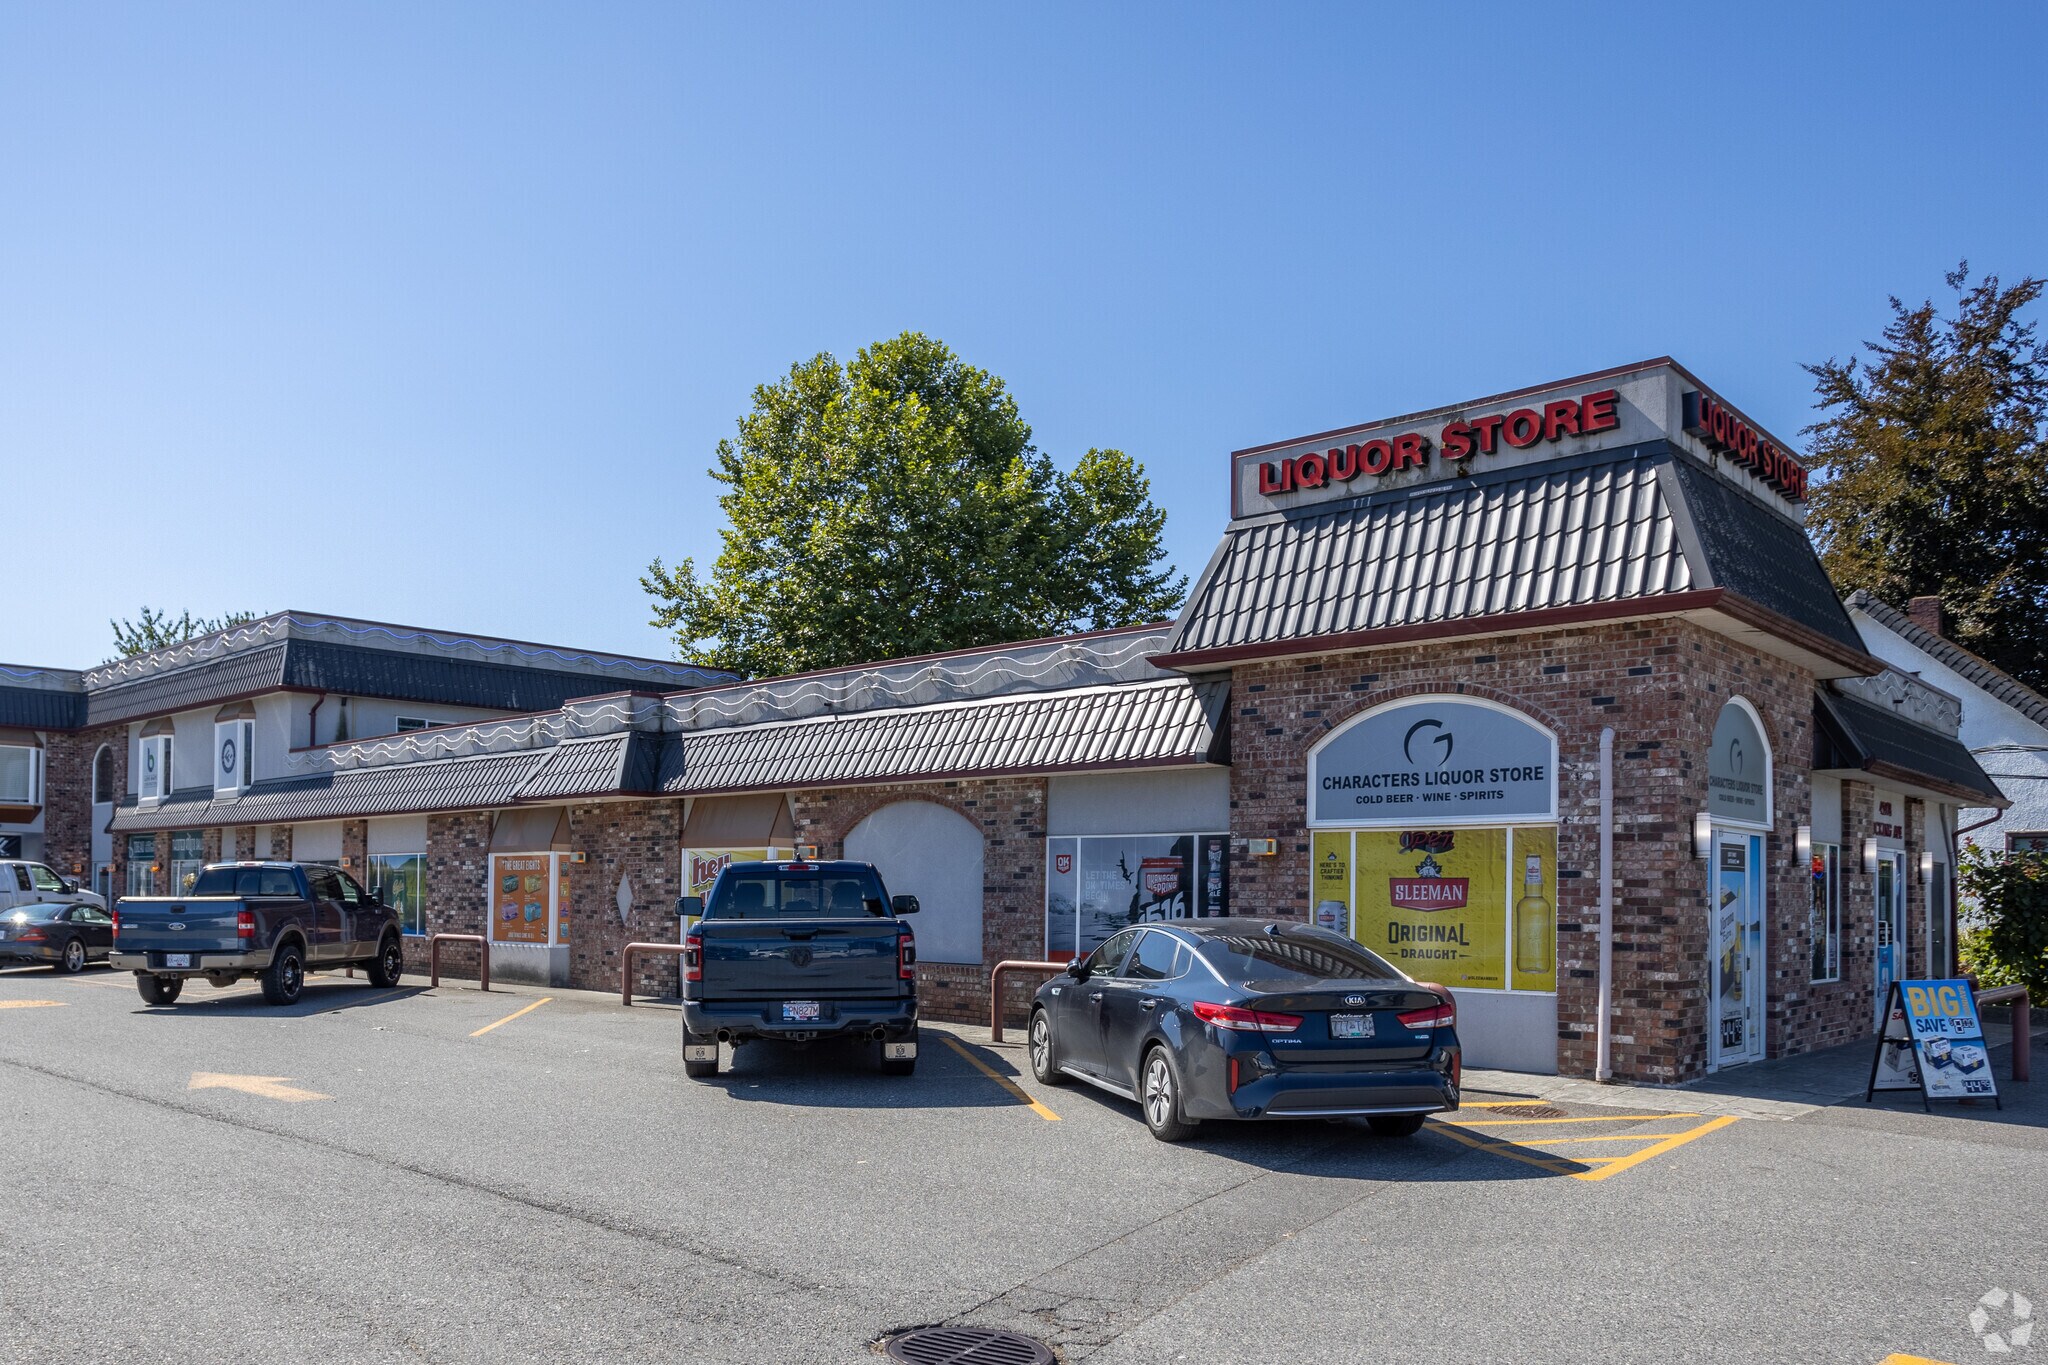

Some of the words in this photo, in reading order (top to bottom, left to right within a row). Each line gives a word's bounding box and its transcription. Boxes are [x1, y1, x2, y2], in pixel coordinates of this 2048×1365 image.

[1259, 432, 1425, 495] LIQUOR
[1441, 389, 1618, 460] STORE
[1698, 390, 1759, 469] LIQUOR
[1763, 440, 1808, 502] STORE
[1323, 772, 1420, 790] CHARACTERS
[1425, 769, 1484, 786] LIQUOR
[1490, 766, 1544, 783] STORE
[1356, 795, 1383, 805] COLD
[1386, 794, 1414, 803] BEER
[1422, 792, 1451, 802] WINE
[1459, 790, 1504, 800] SPIRITS
[1057, 857, 1070, 867] OK
[1085, 870, 1100, 880] LET
[1101, 870, 1117, 880] THE
[1147, 873, 1178, 889] OKANAGAN
[1085, 881, 1096, 890] OK
[1100, 881, 1125, 890] TIMES
[1152, 881, 1178, 894] SPRING
[1395, 884, 1463, 901] SLEEMAN
[1388, 921, 1470, 946] ORIGINAL
[1401, 948, 1458, 960] DRAUGHT
[1907, 985, 1960, 1017] BIG
[1916, 1018, 1948, 1033] SAVE
